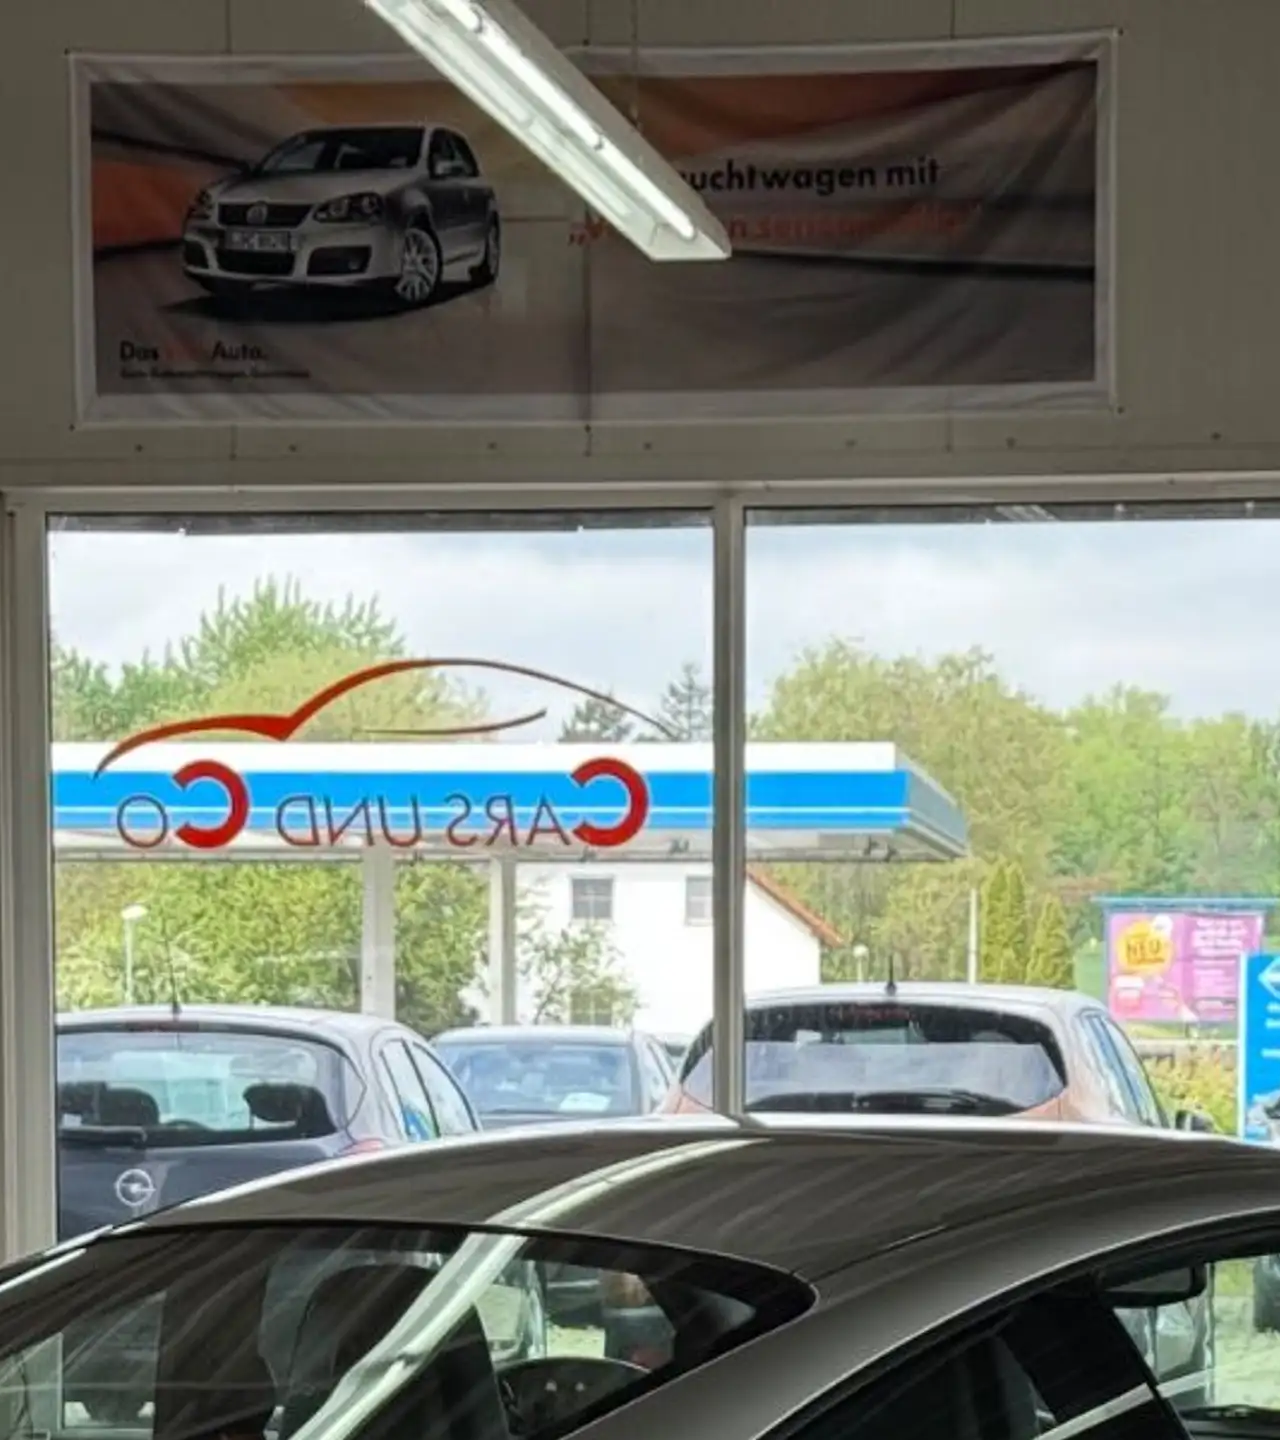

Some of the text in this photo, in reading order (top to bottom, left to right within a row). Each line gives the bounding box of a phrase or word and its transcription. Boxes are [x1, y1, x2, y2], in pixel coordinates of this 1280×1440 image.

[680, 158, 939, 194] uchtwagen mit
[119, 340, 160, 361] Das
